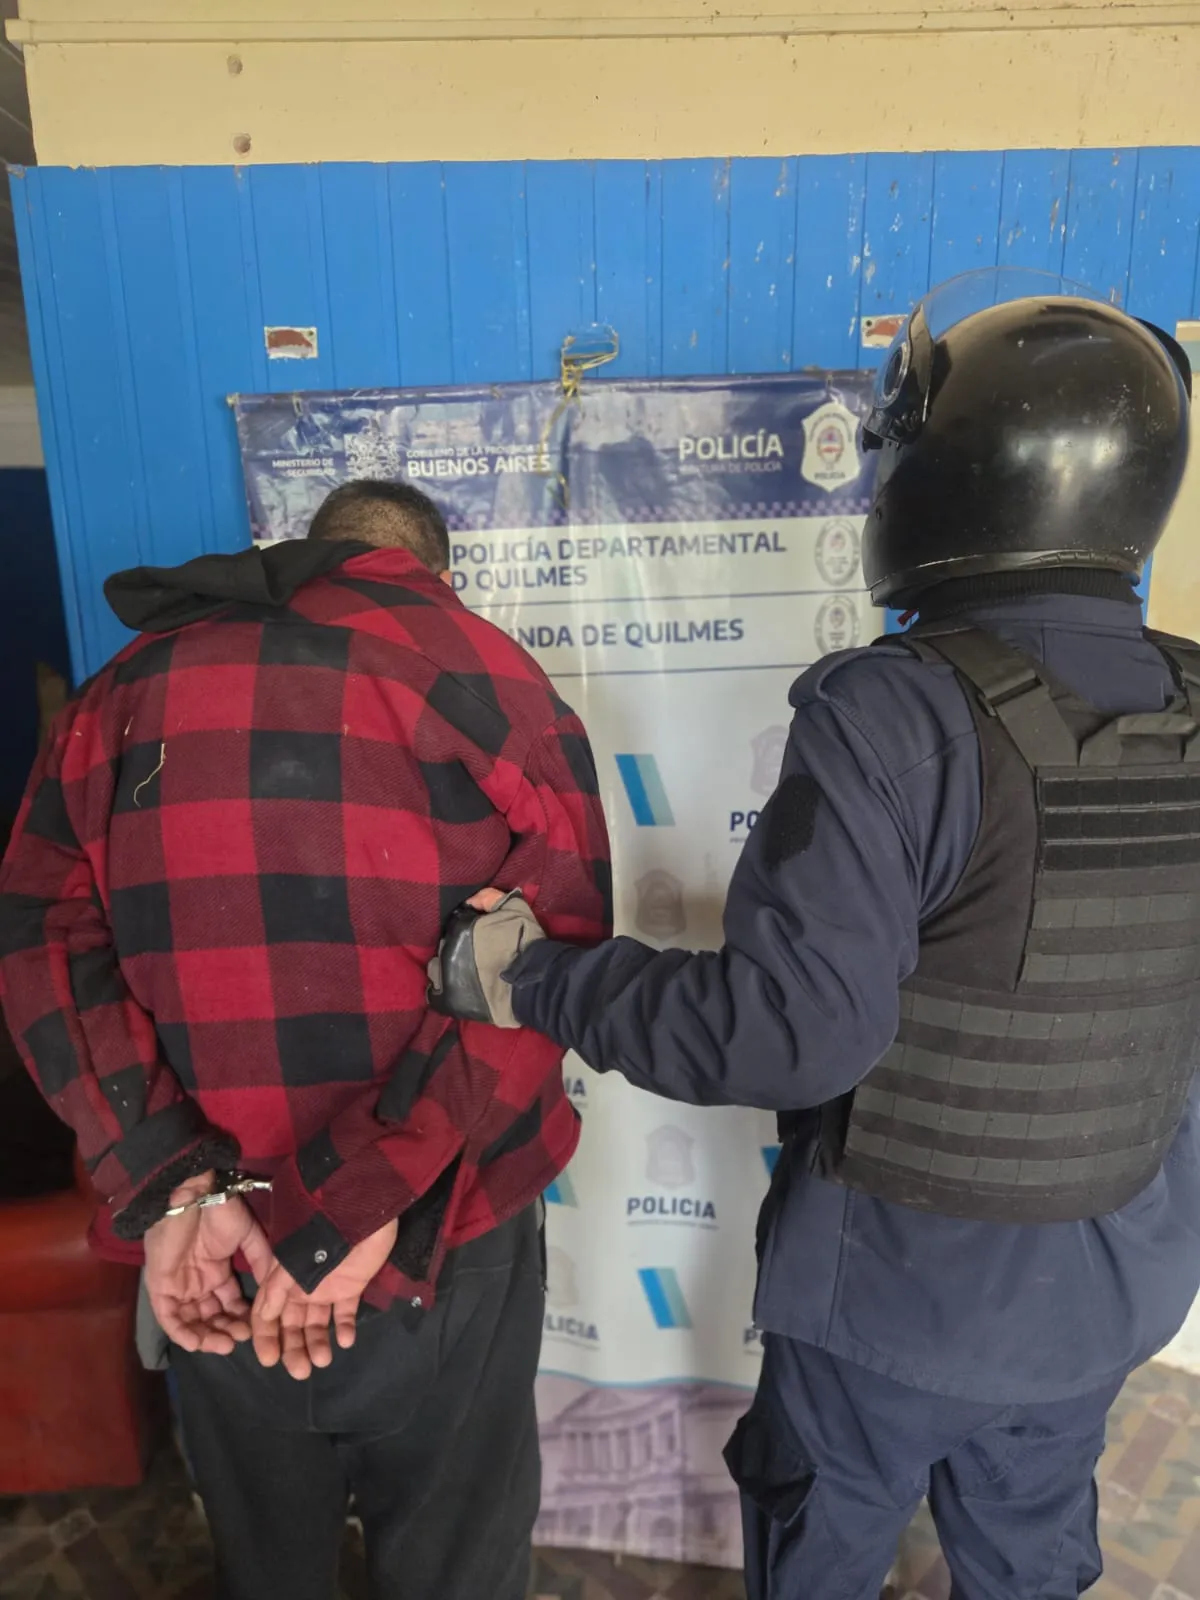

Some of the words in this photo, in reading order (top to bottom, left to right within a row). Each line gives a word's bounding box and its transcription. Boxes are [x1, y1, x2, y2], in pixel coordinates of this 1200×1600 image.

[679, 429, 784, 460] POLICÍA
[407, 457, 490, 477] BUENOS
[494, 453, 551, 473] AIRES
[452, 537, 552, 565] POLICÍA
[558, 531, 787, 561] DEPARTAMENTAL
[475, 565, 587, 592] QUILMES
[581, 623, 617, 647] DE
[624, 618, 744, 648] QUILMES
[627, 1196, 717, 1219] POLICIA
